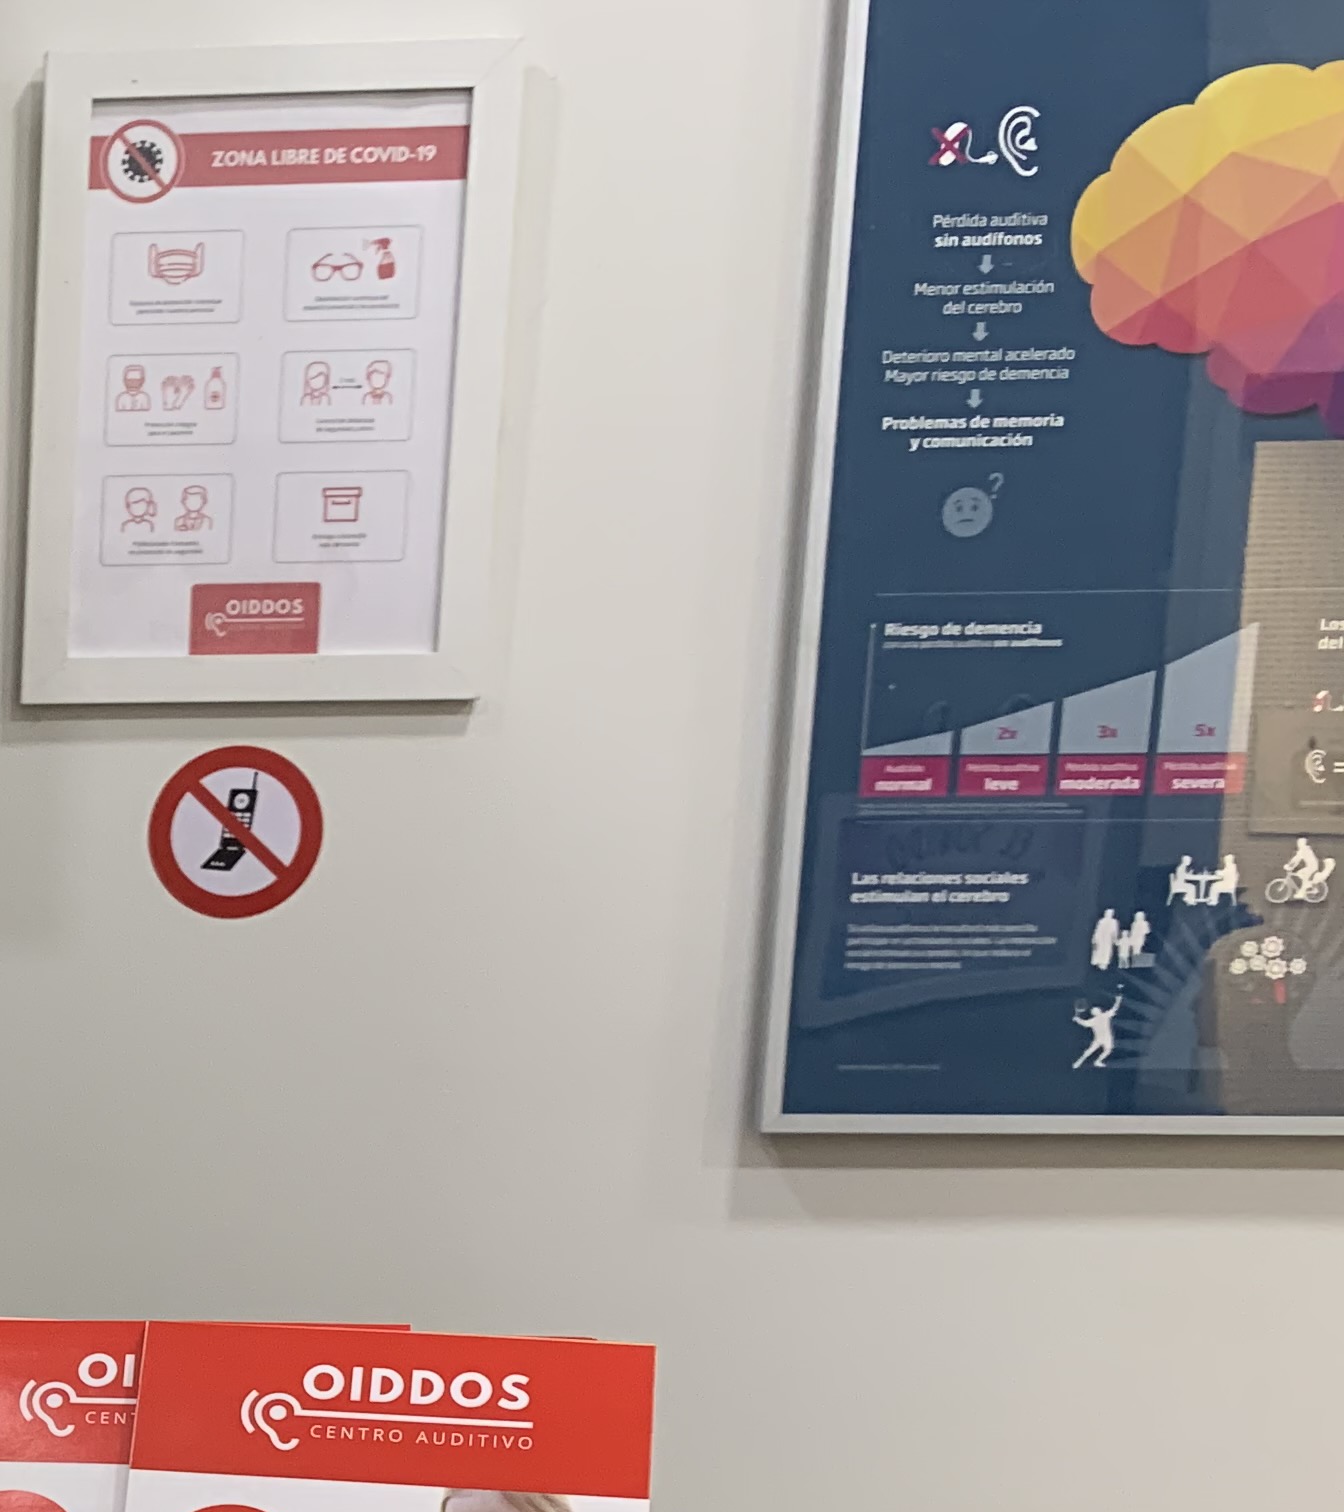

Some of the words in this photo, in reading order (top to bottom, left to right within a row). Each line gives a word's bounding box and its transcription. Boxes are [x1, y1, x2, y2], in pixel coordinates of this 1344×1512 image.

[212, 150, 267, 168] ZONA
[272, 148, 319, 166] LIBRE
[324, 147, 346, 164] DE
[351, 145, 437, 163] COVID-19
[933, 214, 987, 228] Pérdida
[990, 212, 1048, 227] auditiva
[934, 234, 958, 248] sin
[962, 232, 1042, 247] audífonos
[914, 282, 961, 297] Menor
[963, 280, 1054, 296] estimulación
[943, 300, 965, 315] del
[967, 300, 1022, 314] cerebro
[882, 350, 950, 364] Deterioro
[953, 349, 1002, 363] mental
[1005, 346, 1075, 362] acelerado
[883, 369, 929, 386] Mayor
[931, 369, 976, 384] riesgo
[978, 368, 997, 381] de
[999, 366, 1069, 381] demencia
[882, 416, 967, 431] Problemas
[969, 415, 990, 429] de
[993, 413, 1064, 428] memoria
[909, 438, 919, 452] y
[923, 433, 1032, 448] comunicación
[226, 599, 303, 615] OIDDOS
[884, 622, 939, 638] Riesgo
[941, 622, 962, 635] de
[964, 621, 1042, 635] demencia
[302, 1364, 531, 1411] OIDDOS
[309, 1424, 404, 1445] CENTRO
[414, 1429, 534, 1450] AUDITIVO
